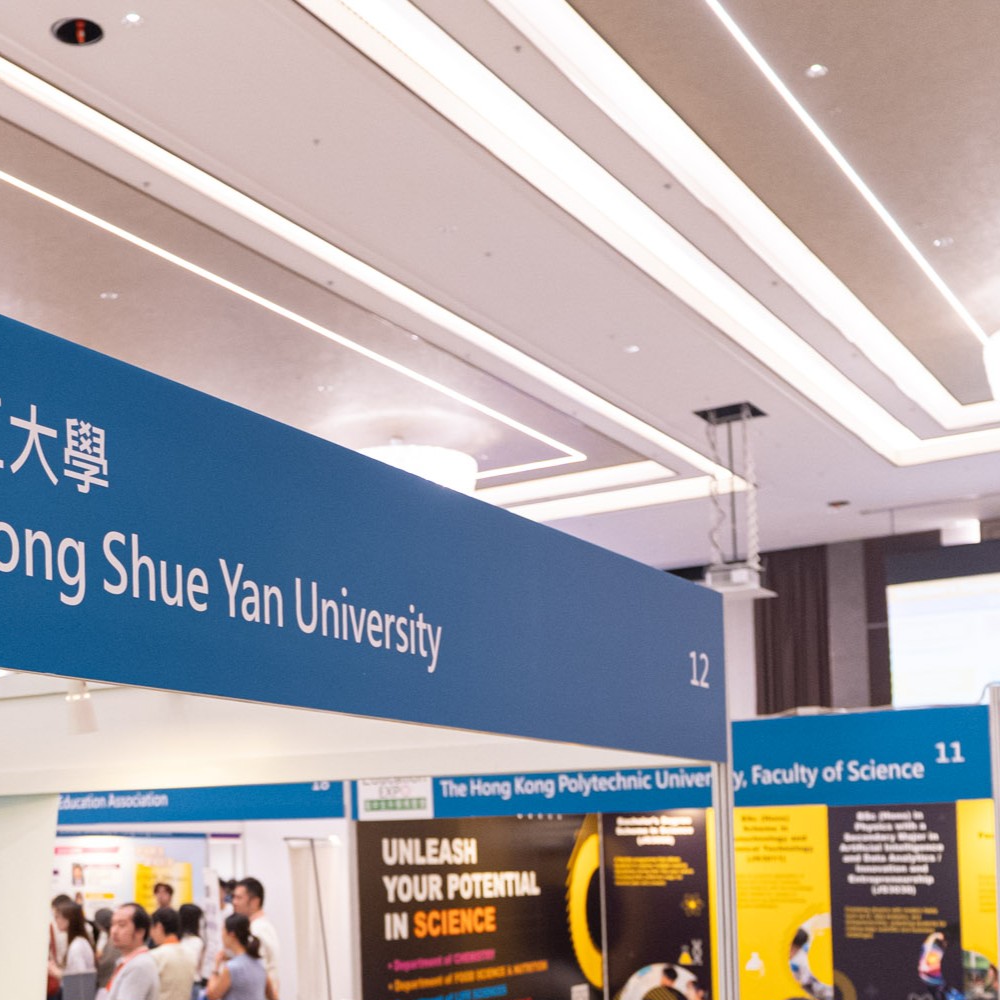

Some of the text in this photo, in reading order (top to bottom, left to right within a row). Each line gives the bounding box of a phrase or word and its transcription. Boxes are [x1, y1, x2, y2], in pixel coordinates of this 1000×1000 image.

[102, 531, 208, 612] Shue
[218, 557, 284, 628] Yan
[295, 577, 442, 673] University
[689, 650, 710, 689] 12
[934, 741, 966, 764] 11
[440, 759, 925, 800] The Hong Kong Polytechnic Univery, Faculty of Science
[381, 838, 477, 866] UNLEASH
[383, 871, 541, 903] YOUR POTENTIAL
[385, 906, 497, 941] IN SCIENCE
